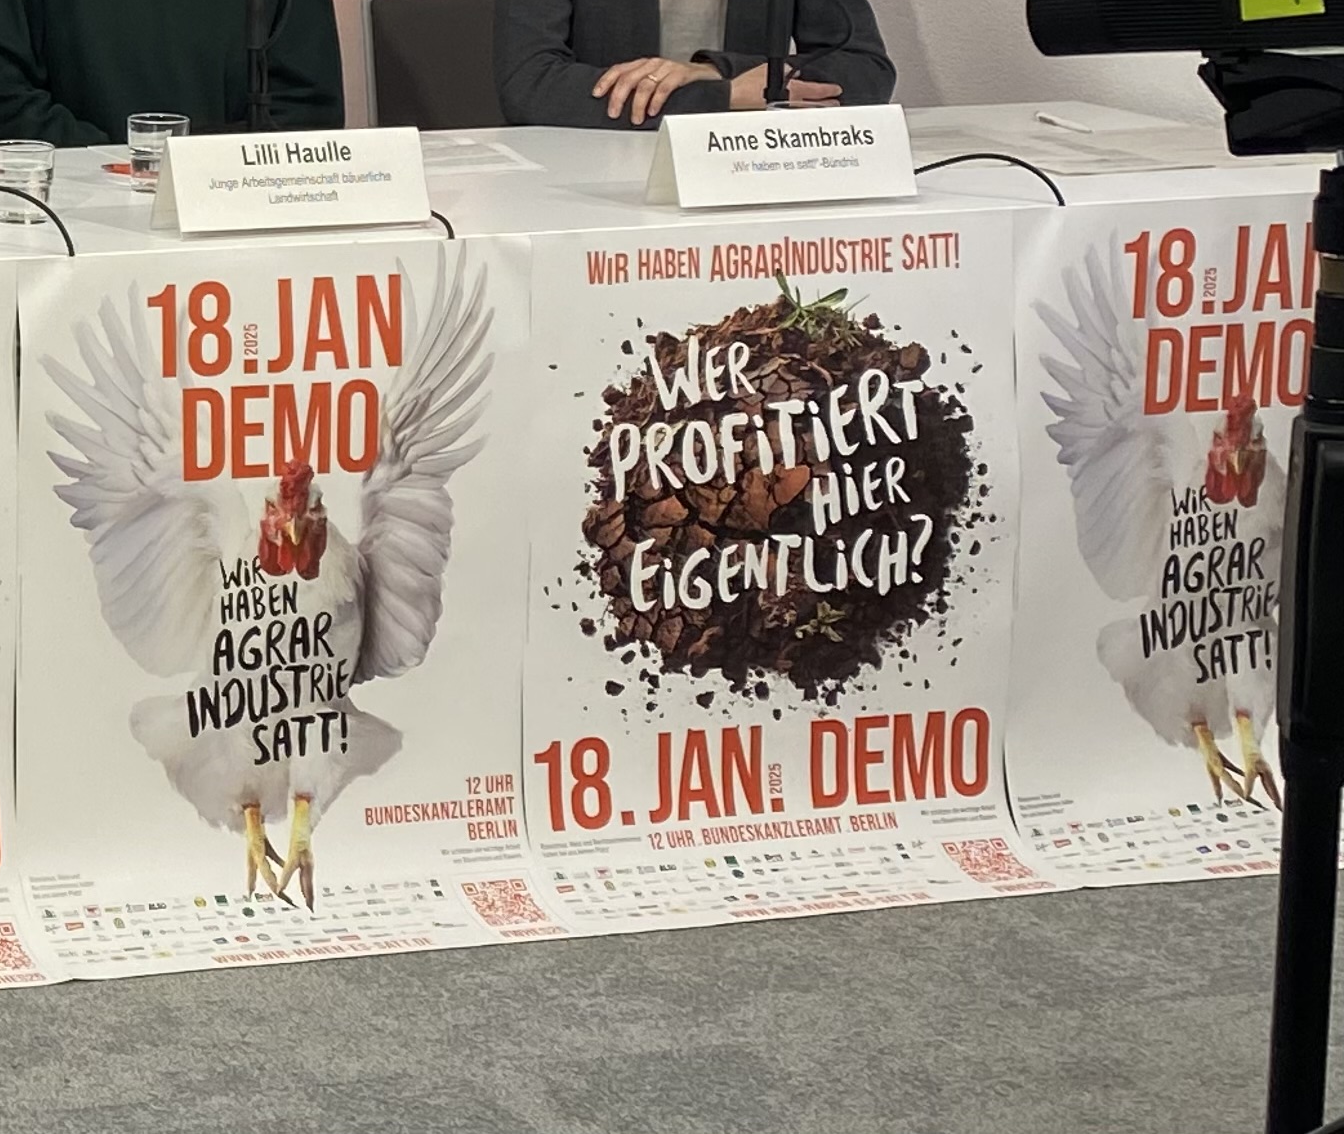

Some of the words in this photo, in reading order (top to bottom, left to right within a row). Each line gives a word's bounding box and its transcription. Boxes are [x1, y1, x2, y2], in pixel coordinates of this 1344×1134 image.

[241, 142, 280, 166] Lilli
[285, 140, 352, 165] Haulle
[707, 130, 760, 154] Anne
[764, 125, 875, 150] Skambraks
[209, 177, 240, 192] Junge
[241, 172, 340, 190] Arbeitsgemeinschaft
[268, 189, 339, 205] Landwirtschaft
[638, 246, 701, 281] HABEN
[902, 232, 960, 269] SATT!
[1124, 222, 1313, 320] 18.JA
[1202, 267, 1218, 297] 2025
[243, 322, 259, 355] 2025
[649, 336, 757, 412] WER
[1144, 318, 1315, 416] DEMO
[182, 378, 380, 482] DEMO
[1170, 509, 1238, 551] HABEN
[1161, 537, 1265, 599] AGRAR
[220, 581, 298, 624] HABEN
[212, 612, 334, 676] AGRAR
[1194, 630, 1273, 684] SATT!
[253, 711, 349, 765] SATT!
[465, 776, 482, 795] 12
[485, 774, 515, 794] UHR
[533, 736, 637, 833] 18.
[810, 707, 991, 809] DEMO
[769, 762, 783, 795] 2025
[365, 796, 515, 826] BUNDESKANZLERAMT
[467, 819, 519, 841] BERLIN
[647, 833, 665, 851] 12
[850, 812, 900, 833] BERLIN
